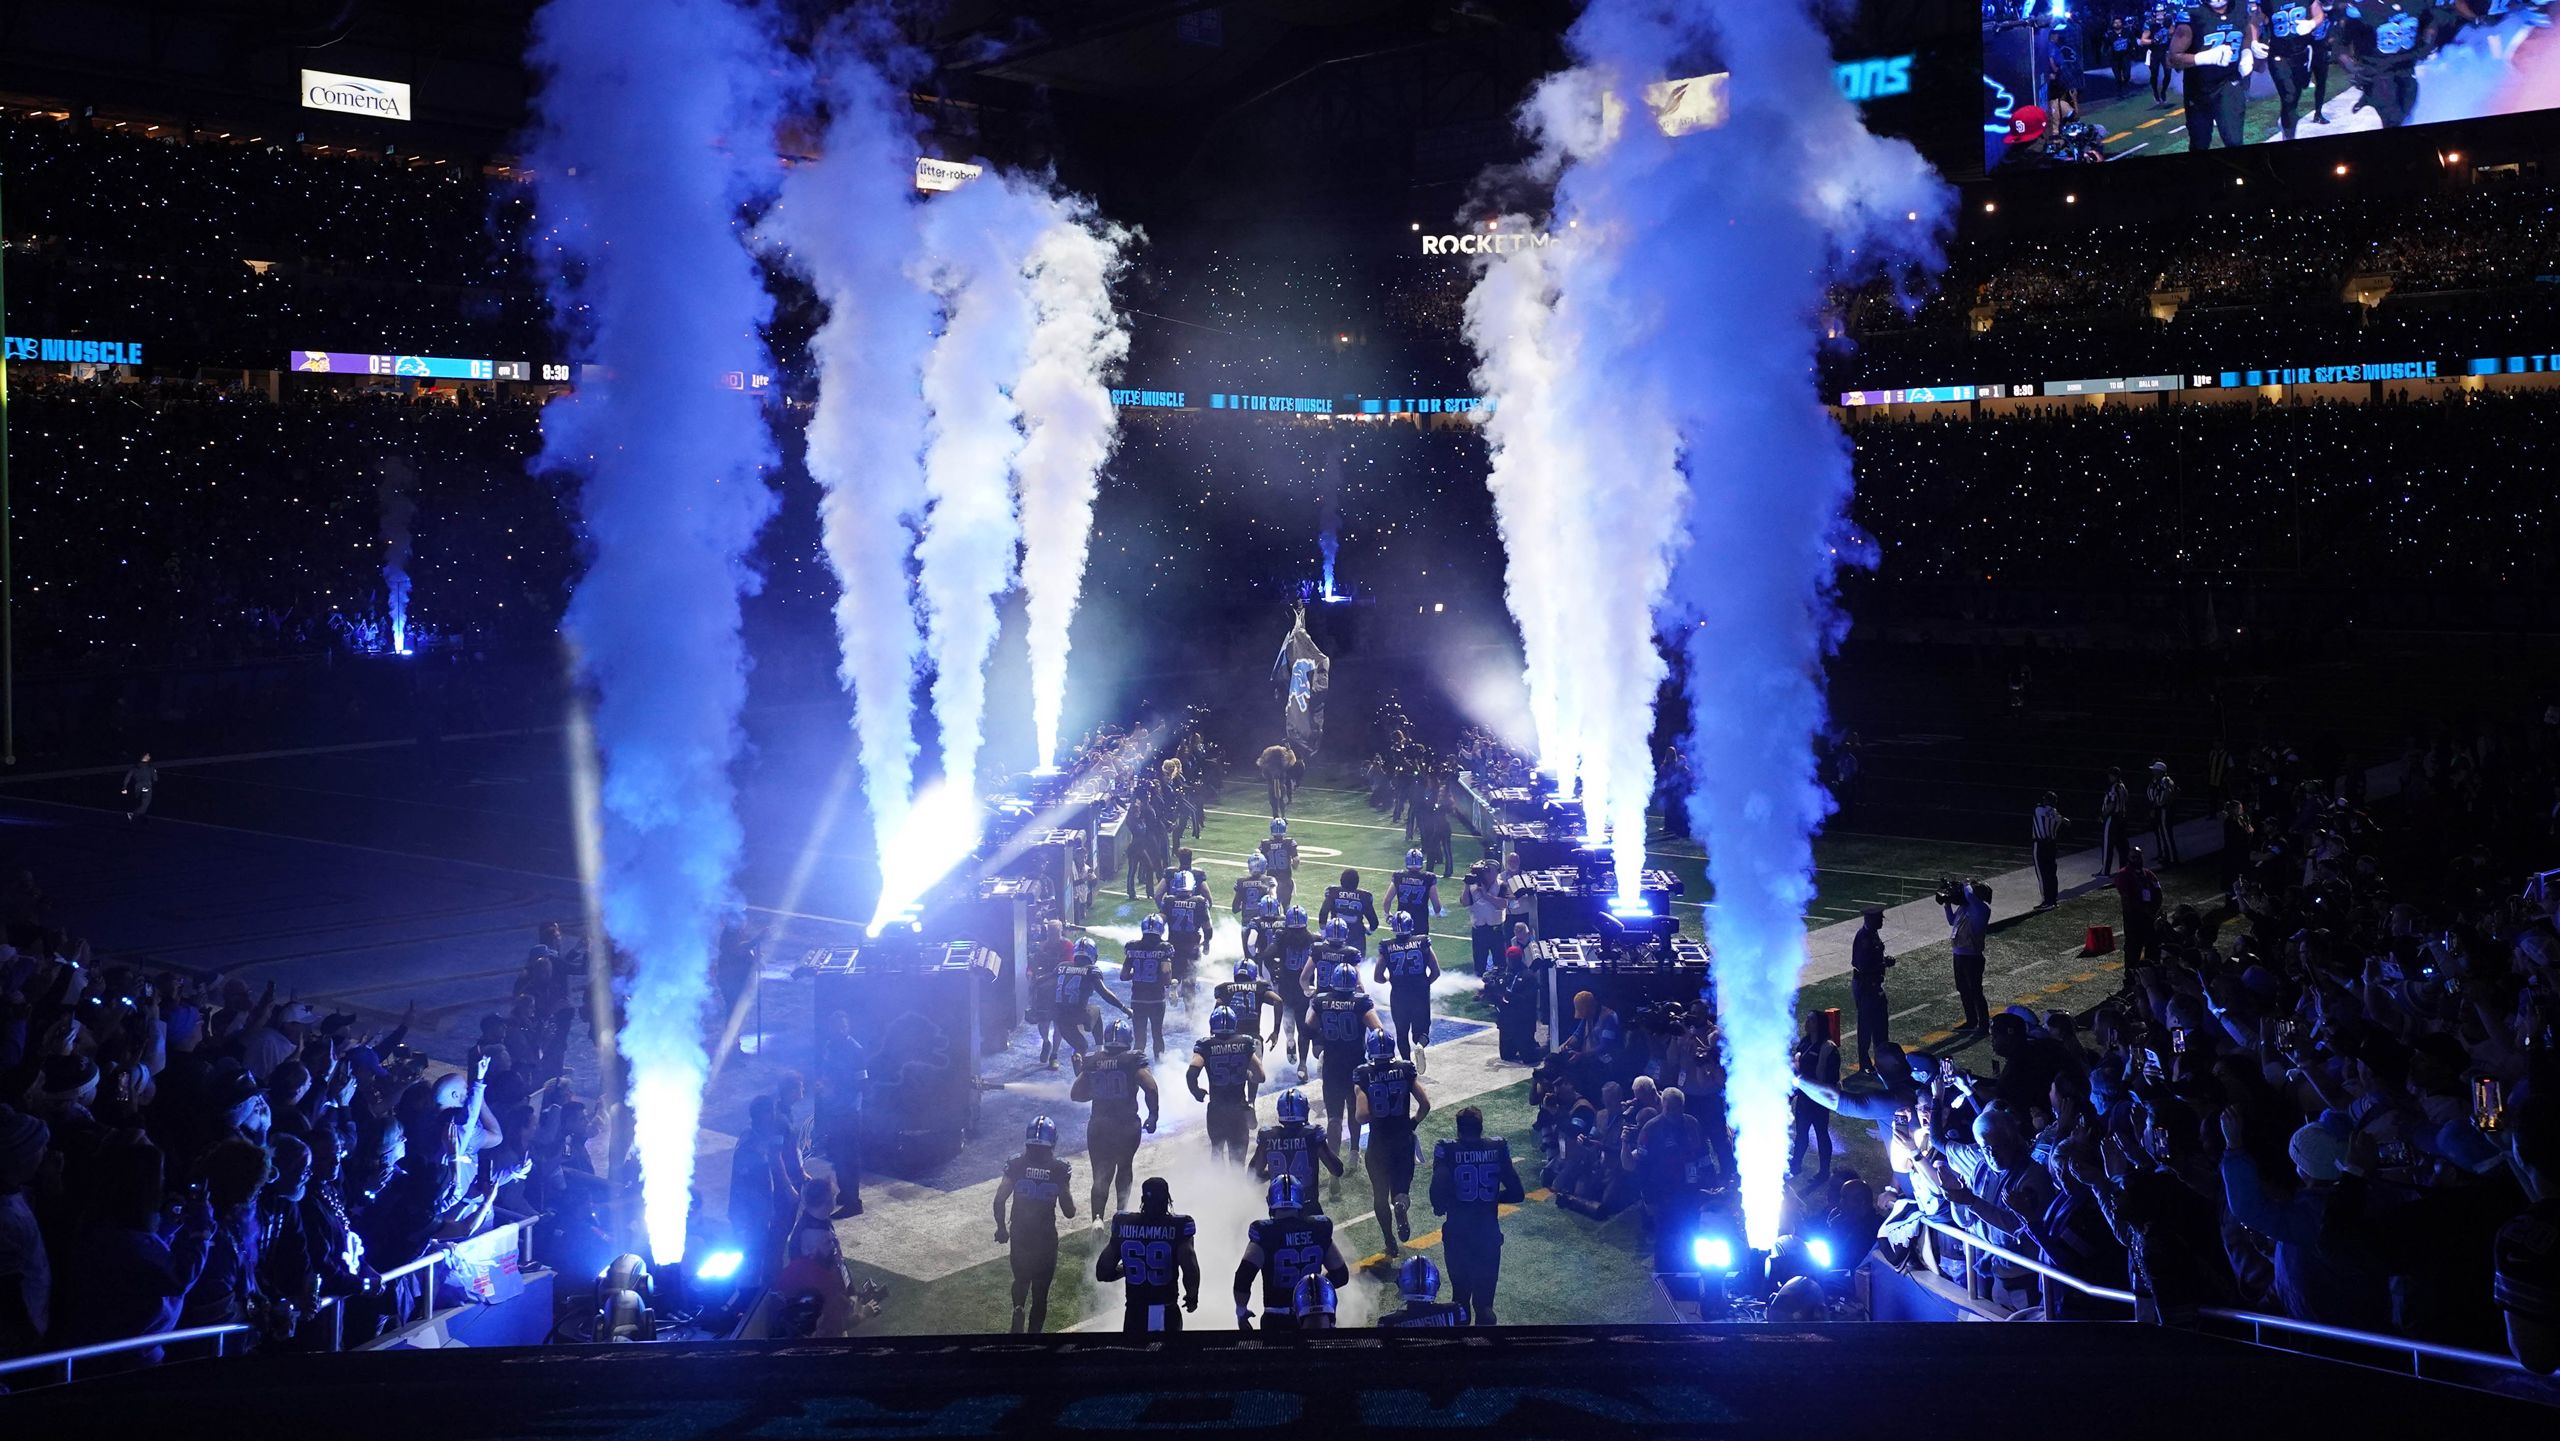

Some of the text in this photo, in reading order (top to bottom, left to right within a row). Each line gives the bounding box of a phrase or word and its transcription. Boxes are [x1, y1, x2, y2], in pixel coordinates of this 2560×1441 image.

[1422, 234, 1525, 255] ROCKET
[41, 338, 142, 365] MUSCLE
[542, 364, 569, 381] 8:30
[2362, 360, 2437, 381] MUSCLE
[2013, 384, 2034, 397] 8:30
[1141, 391, 1185, 408] MUSCLE
[1294, 397, 1333, 413] MUSCLE
[1390, 949, 1425, 976] 73
[1227, 983, 1257, 993] PITTMAN
[1321, 1011, 1358, 1041] 60
[1266, 1137, 1308, 1151] ZYLSTRA
[1025, 1167, 1051, 1180] GIBBS
[1454, 1164, 1500, 1202] 95
[1119, 1225, 1176, 1240] MUHAMMAD
[1285, 1231, 1314, 1246] NIESE
[1121, 1239, 1173, 1287] 69
